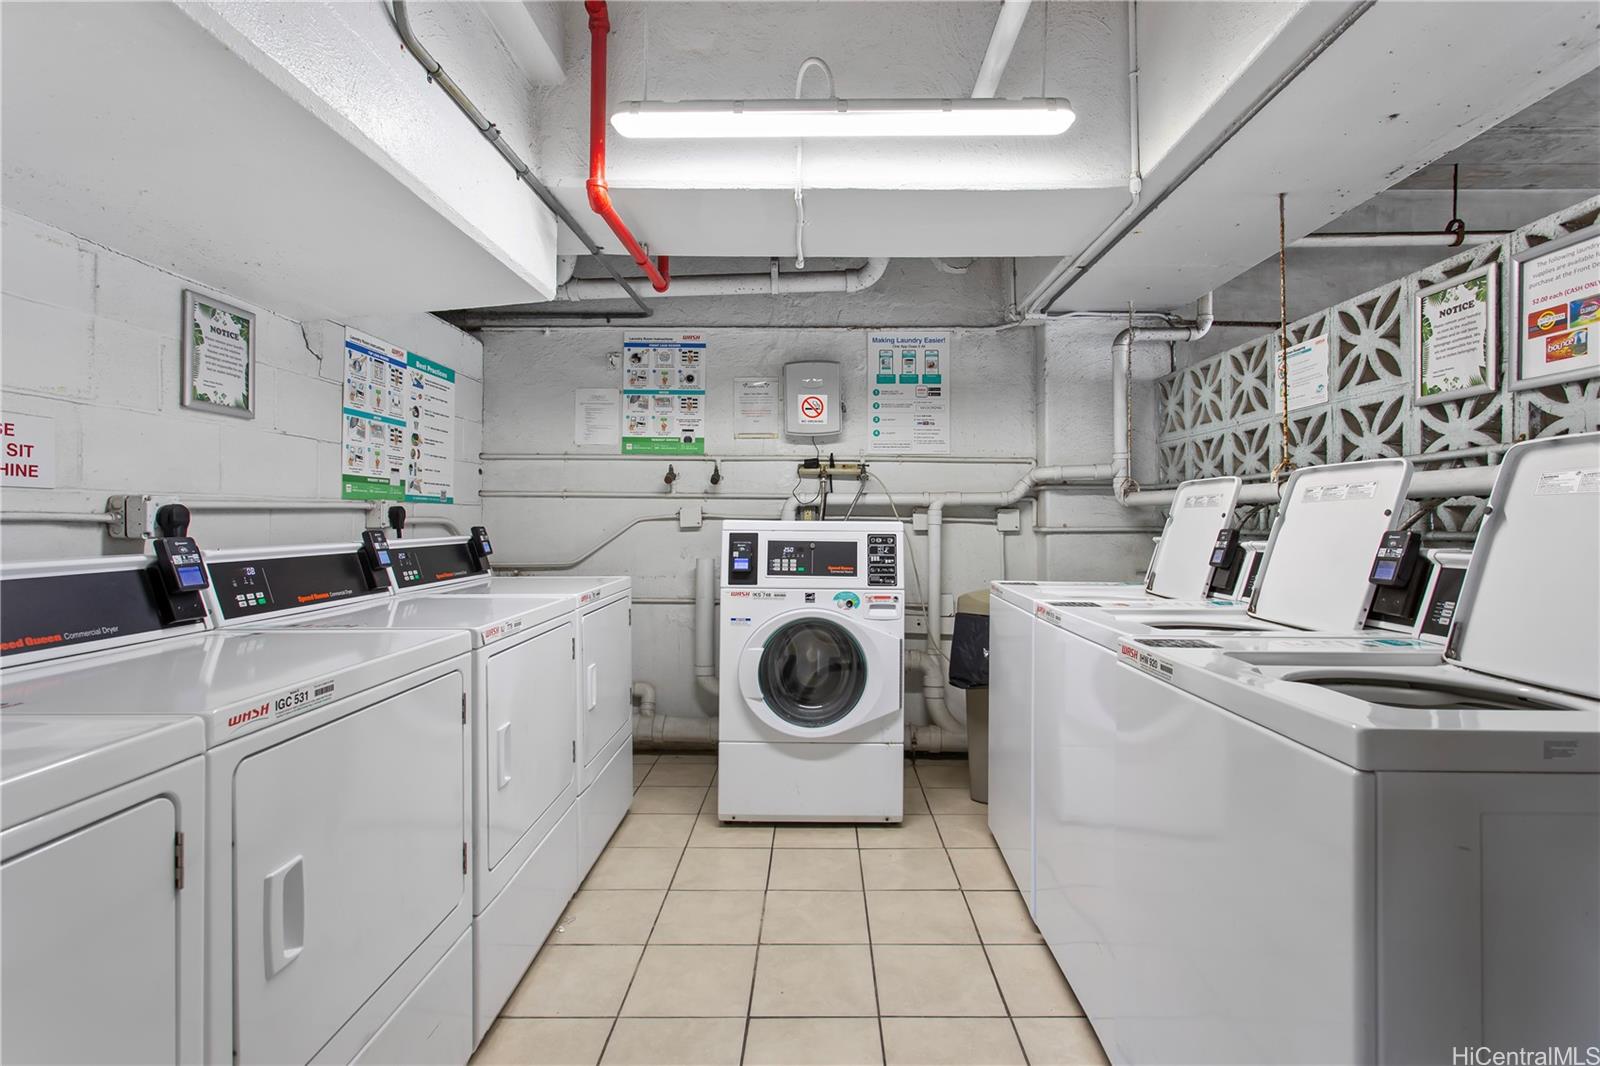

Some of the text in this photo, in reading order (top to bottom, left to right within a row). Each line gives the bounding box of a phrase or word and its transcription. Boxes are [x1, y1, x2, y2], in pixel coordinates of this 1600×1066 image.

[1439, 299, 1476, 319] NOTICE
[209, 325, 240, 341] NOTICE
[896, 336, 923, 344] Laundry
[415, 361, 448, 379] Best Practices
[0, 422, 15, 436] E
[6, 443, 35, 458] SIT
[0, 625, 119, 651] eed Queen Commercial Dryer
[228, 690, 309, 727] WASH IGC 531
